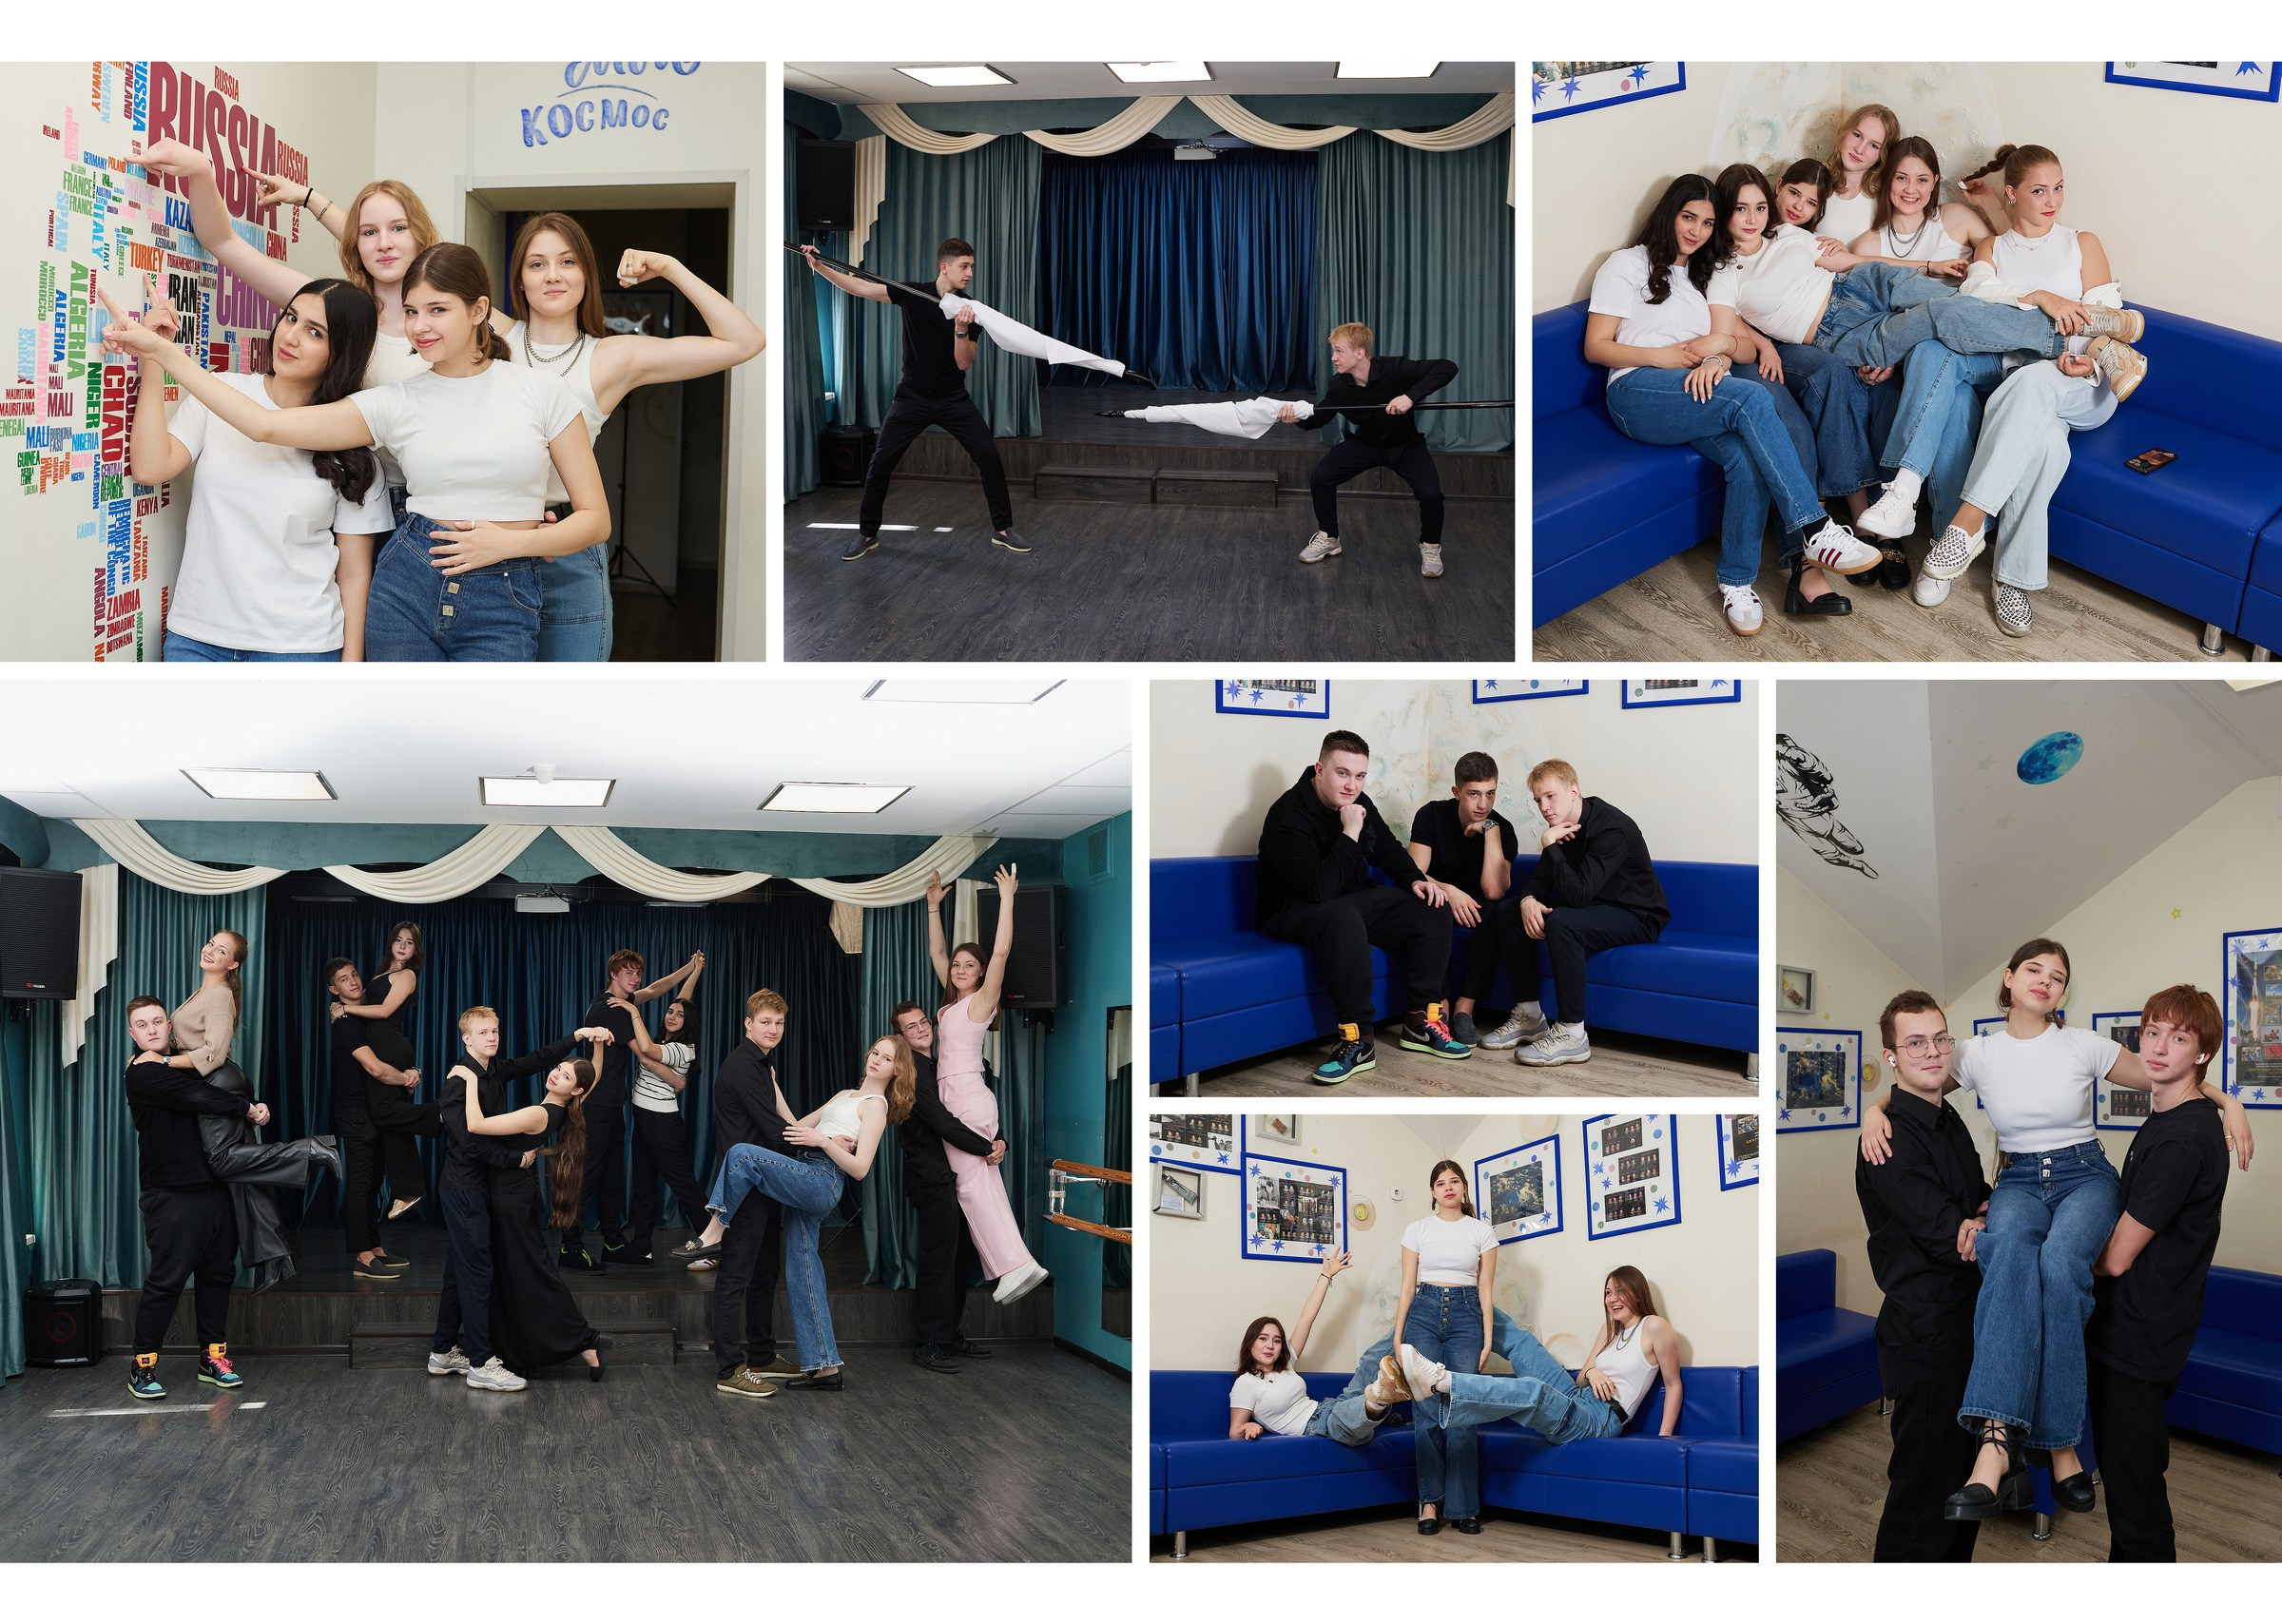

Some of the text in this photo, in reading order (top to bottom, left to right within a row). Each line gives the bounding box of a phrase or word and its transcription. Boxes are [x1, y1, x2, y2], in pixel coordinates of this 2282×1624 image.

[91, 61, 102, 112] RWAY
[124, 62, 133, 120] FINLAND
[214, 66, 239, 102] RUSSIA
[43, 125, 61, 140] IRELAND
[146, 62, 277, 231] RUSSIA
[84, 151, 107, 170] GERMANY
[108, 156, 126, 173] POLAND
[277, 140, 309, 187] RUSSIA
[64, 170, 93, 198] FRANCE
[55, 191, 68, 252] SPAIN
[69, 195, 93, 217] FRANCE
[165, 196, 196, 233] KAZA
[92, 203, 106, 260] ITALY
[151, 222, 169, 238] ARMENIA
[291, 205, 300, 243] SSIA
[129, 241, 164, 274] TURKEY
[266, 231, 287, 262] CHINA
[166, 253, 201, 274] TURKMENISTAN
[38, 261, 48, 321] MOROCCO
[48, 266, 56, 312] MOROCCO
[167, 273, 198, 314] IRAN
[53, 289, 67, 362] ALGERIA
[68, 261, 88, 380] ALGERIA
[173, 315, 195, 344] RAN
[200, 293, 210, 369] PAKISTAN
[36, 322, 49, 424] MAURITANIA
[48, 364, 58, 374] MALI
[48, 377, 63, 390] MALI
[0, 402, 35, 416] MAURITANIA
[6, 388, 35, 400] MAURITANIA
[48, 393, 73, 417] MALI
[86, 362, 103, 429] NIGER
[164, 387, 179, 401] EMEN
[0, 418, 26, 437] ENEGAL
[101, 365, 126, 463] CHAD
[26, 425, 49, 449] MALI
[72, 433, 99, 452] NIGERIA
[17, 451, 40, 468] GUINEA
[92, 454, 101, 510] CAMEROON
[161, 479, 170, 508] LIA
[136, 496, 158, 517] KENYA
[133, 518, 142, 583] TANZANIA
[106, 550, 116, 596] CONGO
[93, 568, 106, 638] ANGOLA
[106, 589, 141, 621] ZAMBIA
[106, 613, 136, 639] ZIMBABWE
[106, 631, 133, 654] BOTSWANA
